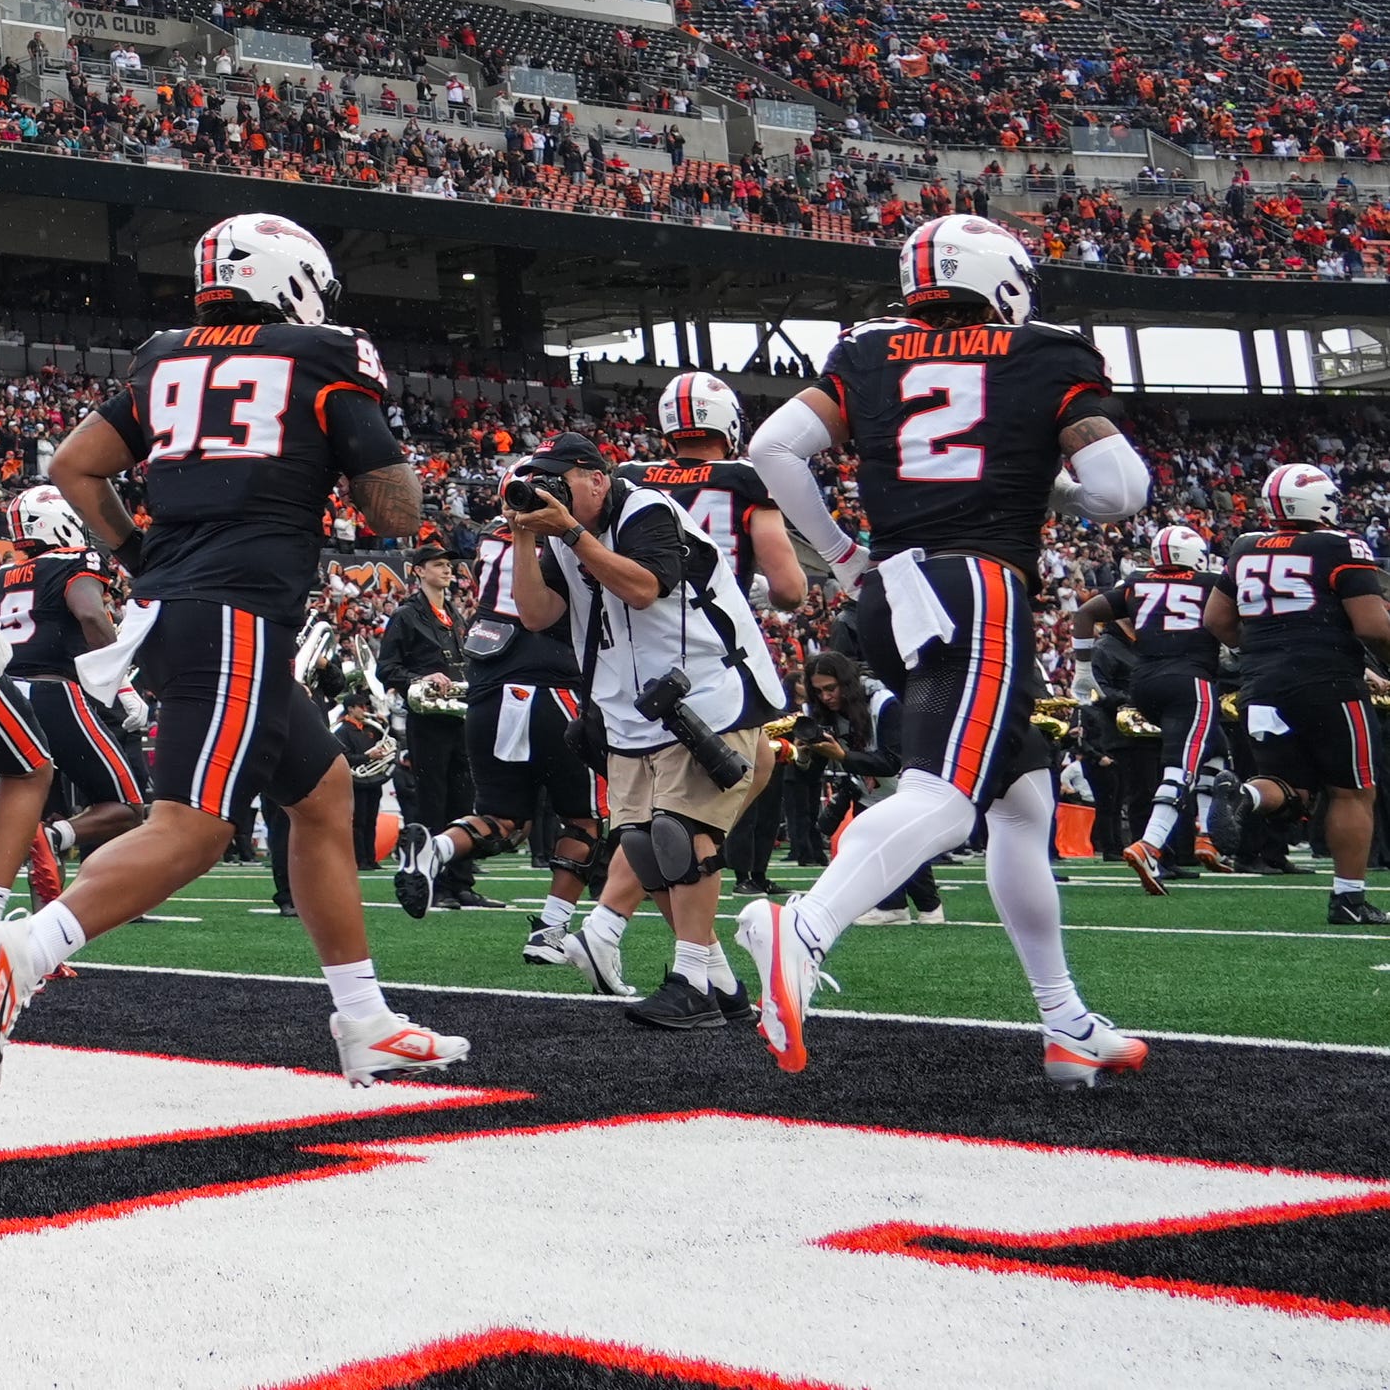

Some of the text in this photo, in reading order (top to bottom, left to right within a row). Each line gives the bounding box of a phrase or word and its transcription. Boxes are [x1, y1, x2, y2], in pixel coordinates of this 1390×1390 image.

[78, 28, 95, 38] 220
[112, 16, 156, 36] CLUB
[946, 246, 953, 254] 2
[906, 289, 951, 306] BEAVERS
[183, 324, 263, 347] FINAU
[887, 330, 1013, 361] SULLIVAN
[148, 355, 295, 460] 93
[897, 361, 986, 481] 2
[642, 465, 713, 484] SIEGNER
[85, 551, 101, 571] 9
[4, 564, 37, 588] DAVIS
[1236, 554, 1316, 617] 65
[1134, 582, 1204, 631] 75
